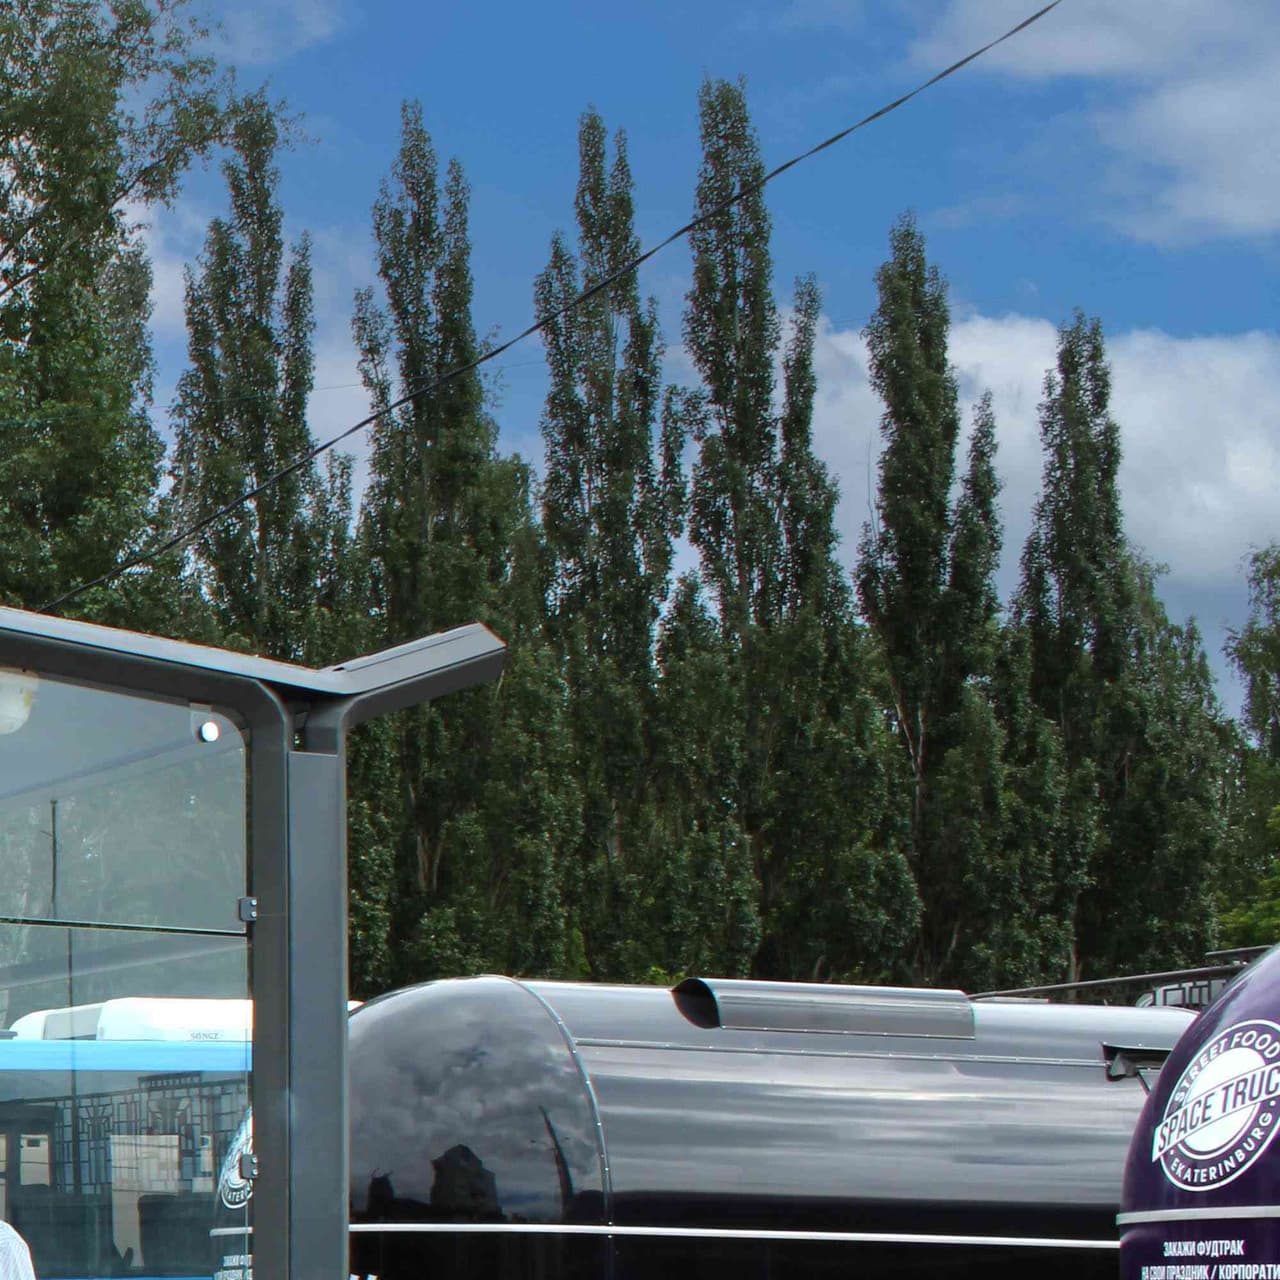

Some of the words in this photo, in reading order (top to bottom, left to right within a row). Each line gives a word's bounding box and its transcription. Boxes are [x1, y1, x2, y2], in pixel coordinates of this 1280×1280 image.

[1174, 1038, 1229, 1103] STREET
[1230, 1029, 1280, 1060] FOOD
[1157, 1092, 1215, 1153] SPACE
[1170, 1112, 1273, 1184] EKATERINBURG
[1163, 1241, 1196, 1257] ЗАКАЖИ
[1196, 1239, 1244, 1257] ФУДТРАК
